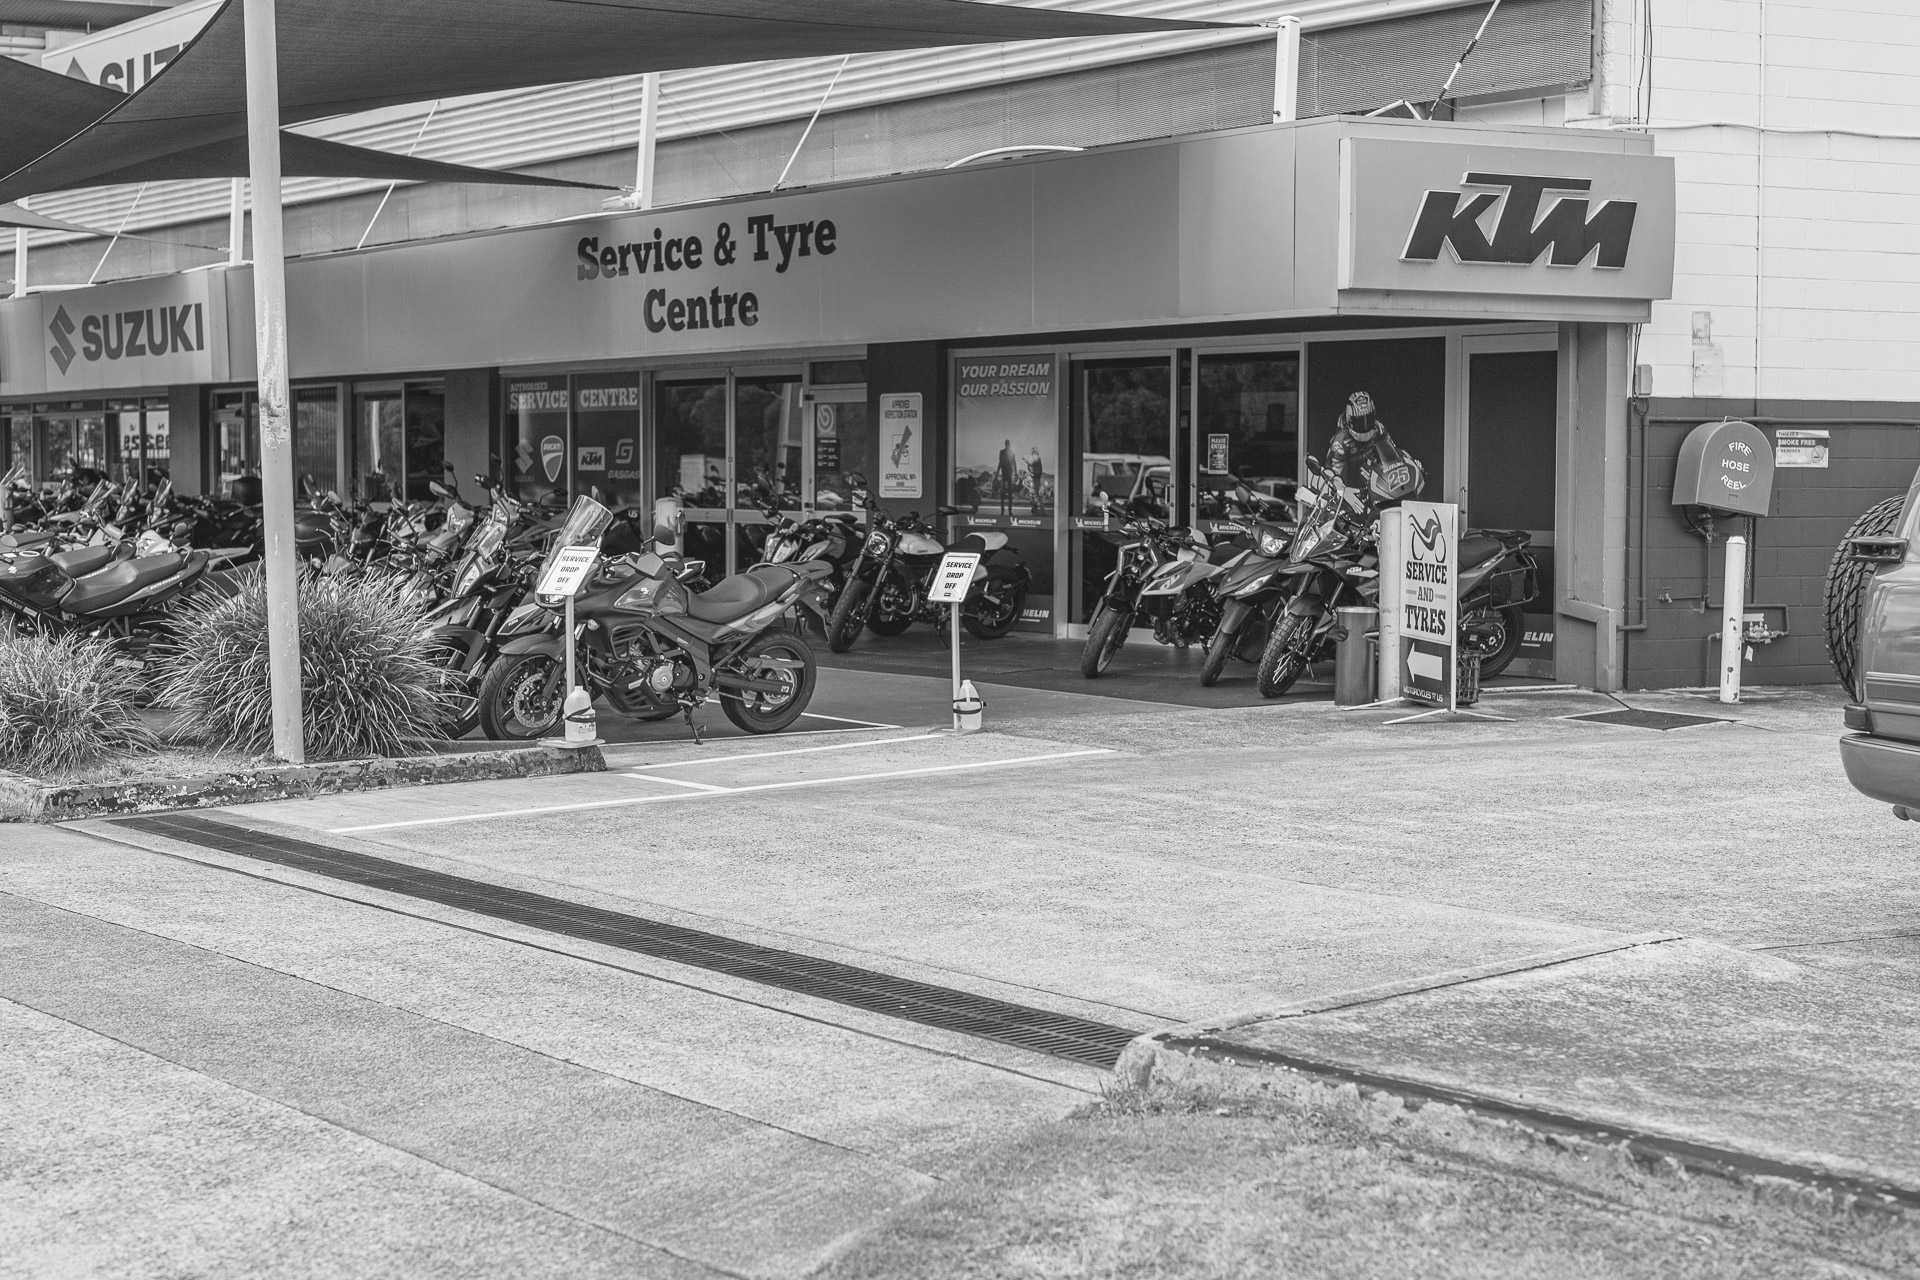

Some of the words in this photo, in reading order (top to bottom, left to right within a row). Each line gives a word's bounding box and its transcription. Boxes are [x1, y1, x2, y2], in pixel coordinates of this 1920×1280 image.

[1399, 171, 1638, 269] KTM
[577, 227, 703, 280] Service
[714, 222, 736, 266] &
[748, 214, 837, 273] Tyre
[643, 286, 759, 333] Centre
[81, 302, 204, 361] SUZUKI
[961, 365, 997, 378] YOUR
[999, 363, 1050, 377] DREAM
[510, 382, 548, 391] AUTHORISED
[960, 383, 988, 396] OUR
[990, 382, 1050, 395] PASSION
[510, 390, 568, 410] SERVICE
[580, 387, 638, 407] CENTRE
[543, 442, 561, 450] DUCATI
[1728, 441, 1752, 456] FIRE
[581, 451, 602, 465] KTM
[1722, 459, 1750, 472] HOSE
[608, 470, 640, 479] GASGAS
[1388, 466, 1410, 492] 25
[1721, 474, 1746, 490] REEL
[946, 561, 973, 569] SERVICE
[1405, 560, 1447, 584] SERVICE
[1417, 586, 1434, 602] AND
[1404, 604, 1446, 636] TYRES
[1437, 693, 1443, 702] US
